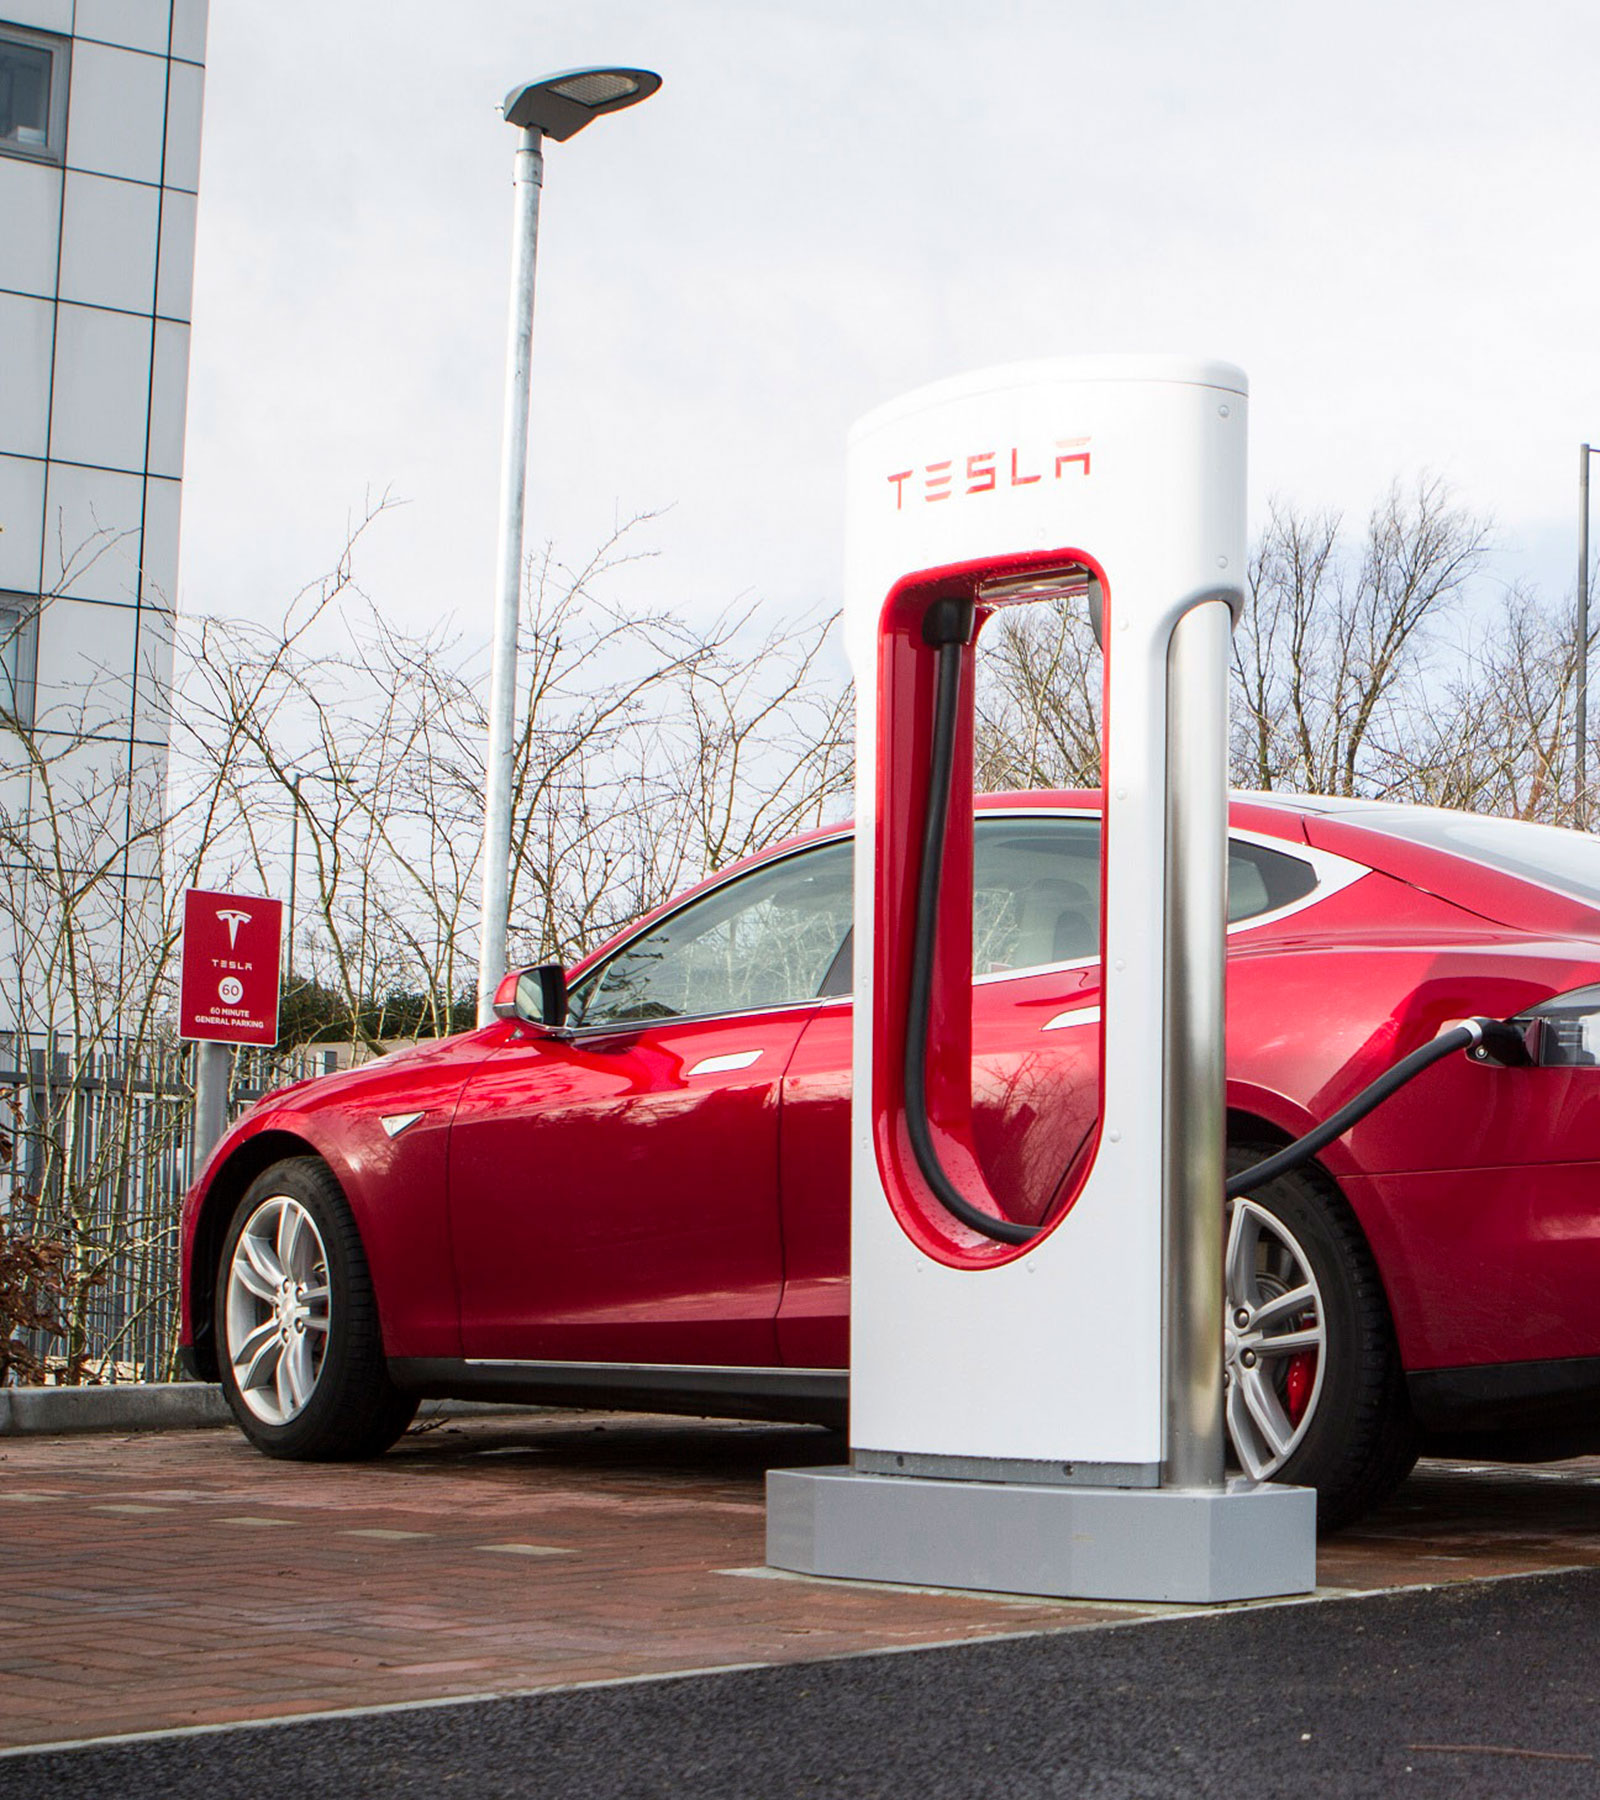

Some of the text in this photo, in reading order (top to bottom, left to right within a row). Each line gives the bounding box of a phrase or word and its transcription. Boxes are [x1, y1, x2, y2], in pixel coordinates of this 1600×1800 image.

[887, 436, 1092, 511] TESLA
[211, 958, 253, 971] TESLA
[222, 984, 240, 997] 60
[210, 1006, 250, 1018] 60 MINUTE
[194, 1015, 264, 1029] GENERAL PARKING
